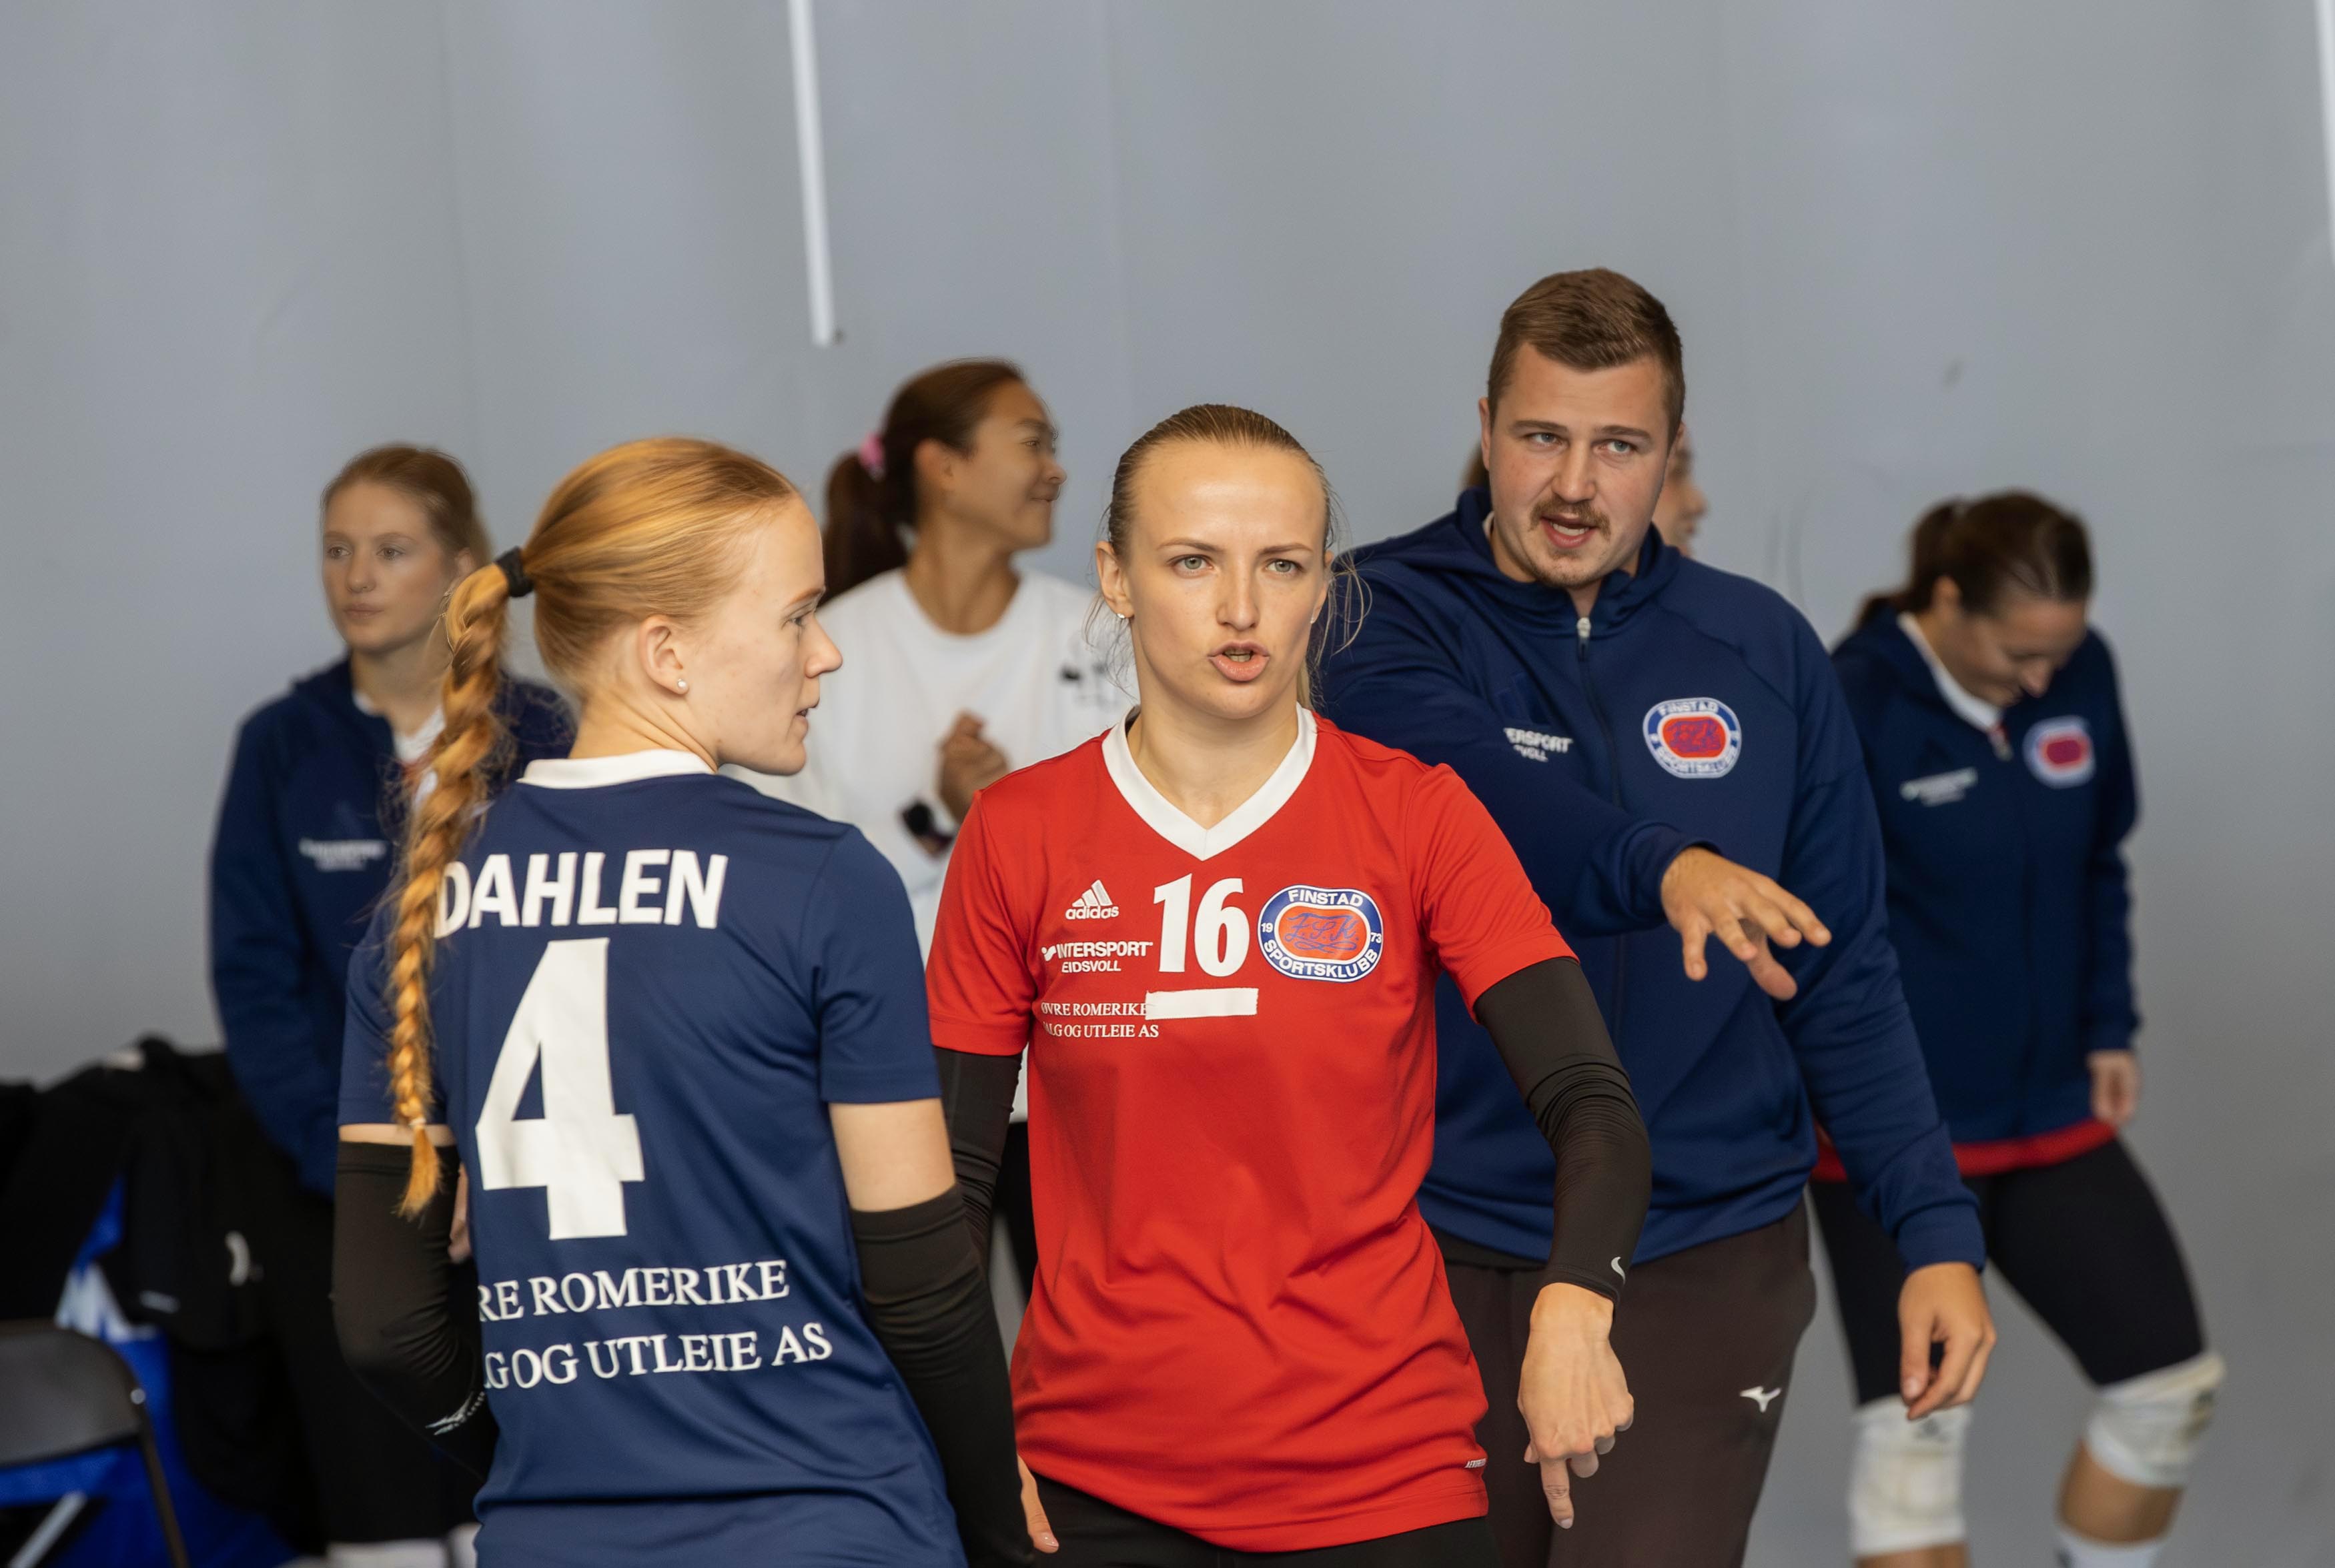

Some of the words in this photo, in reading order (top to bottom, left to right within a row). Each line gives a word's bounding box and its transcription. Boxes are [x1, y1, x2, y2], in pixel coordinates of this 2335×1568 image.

[434, 849, 729, 938] DAHLEN
[1288, 890, 1364, 907] FINSTAD
[1065, 905, 1119, 920] adidas
[1153, 873, 1250, 977] 16
[1261, 922, 1274, 933] 19
[1370, 932, 1382, 943] 73
[1056, 941, 1150, 959] INTERSPORT
[1264, 940, 1378, 978] SPORTSKLUBB
[1061, 960, 1121, 972] EIDSVOLL
[1064, 1024, 1081, 1038] OG
[1084, 1024, 1135, 1038] UTLEIE
[1138, 1024, 1159, 1038] AS
[474, 937, 645, 1240] 4
[527, 1259, 790, 1316] ROMERIKE
[512, 1343, 579, 1389] OG
[583, 1331, 762, 1379] UTLEIE
[771, 1322, 833, 1366] AS
